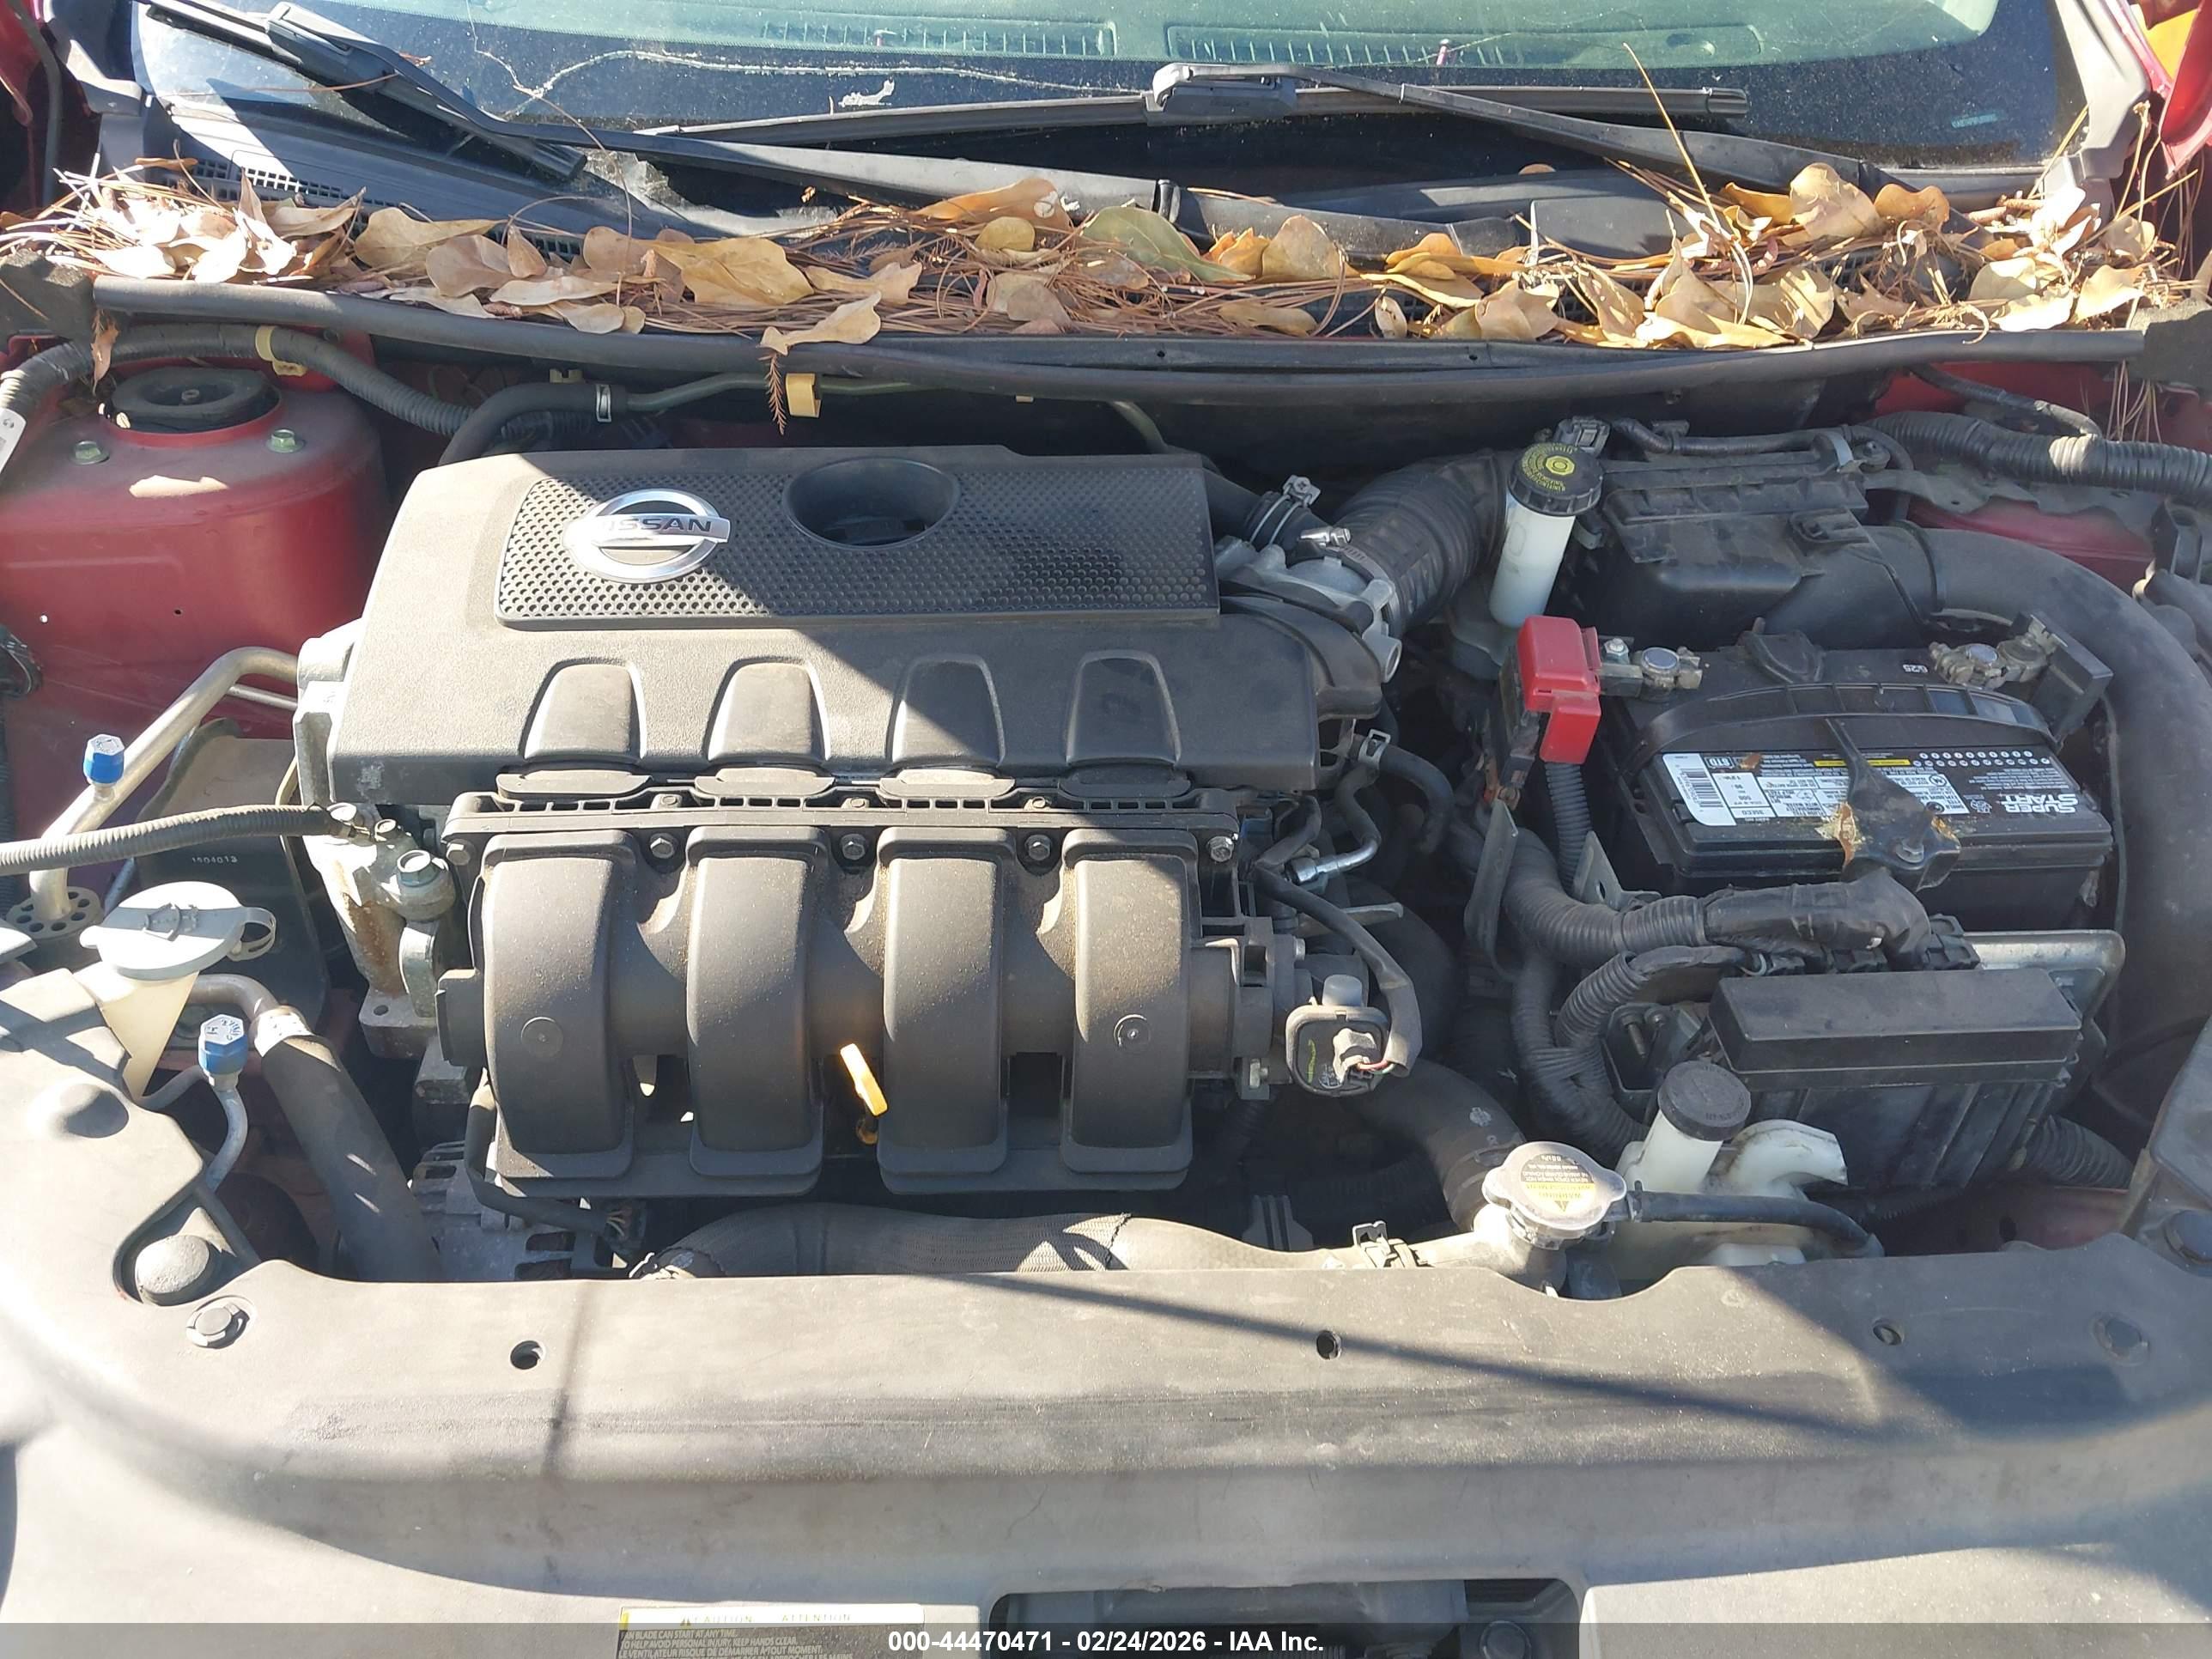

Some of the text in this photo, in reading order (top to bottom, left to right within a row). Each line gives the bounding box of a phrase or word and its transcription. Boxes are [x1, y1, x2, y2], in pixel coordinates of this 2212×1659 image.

[2001, 793, 2078, 805] START
[2004, 803, 2076, 813] SUPER
[635, 1631, 658, 1640] BLADE
[658, 1631, 674, 1639] CAN
[674, 1630, 695, 1639] START
[695, 1630, 705, 1638] AT
[705, 1629, 721, 1638] ANY
[631, 1639, 649, 1650] HELP
[649, 1639, 671, 1649] AVOID
[671, 1638, 708, 1648] PERSONAL
[733, 1638, 750, 1647] KEEP
[750, 1637, 774, 1646] HANDS
[629, 1649, 677, 1659] VENTILATEUR
[678, 1648, 705, 1657] RISQUE
[706, 1648, 718, 1657] DE
